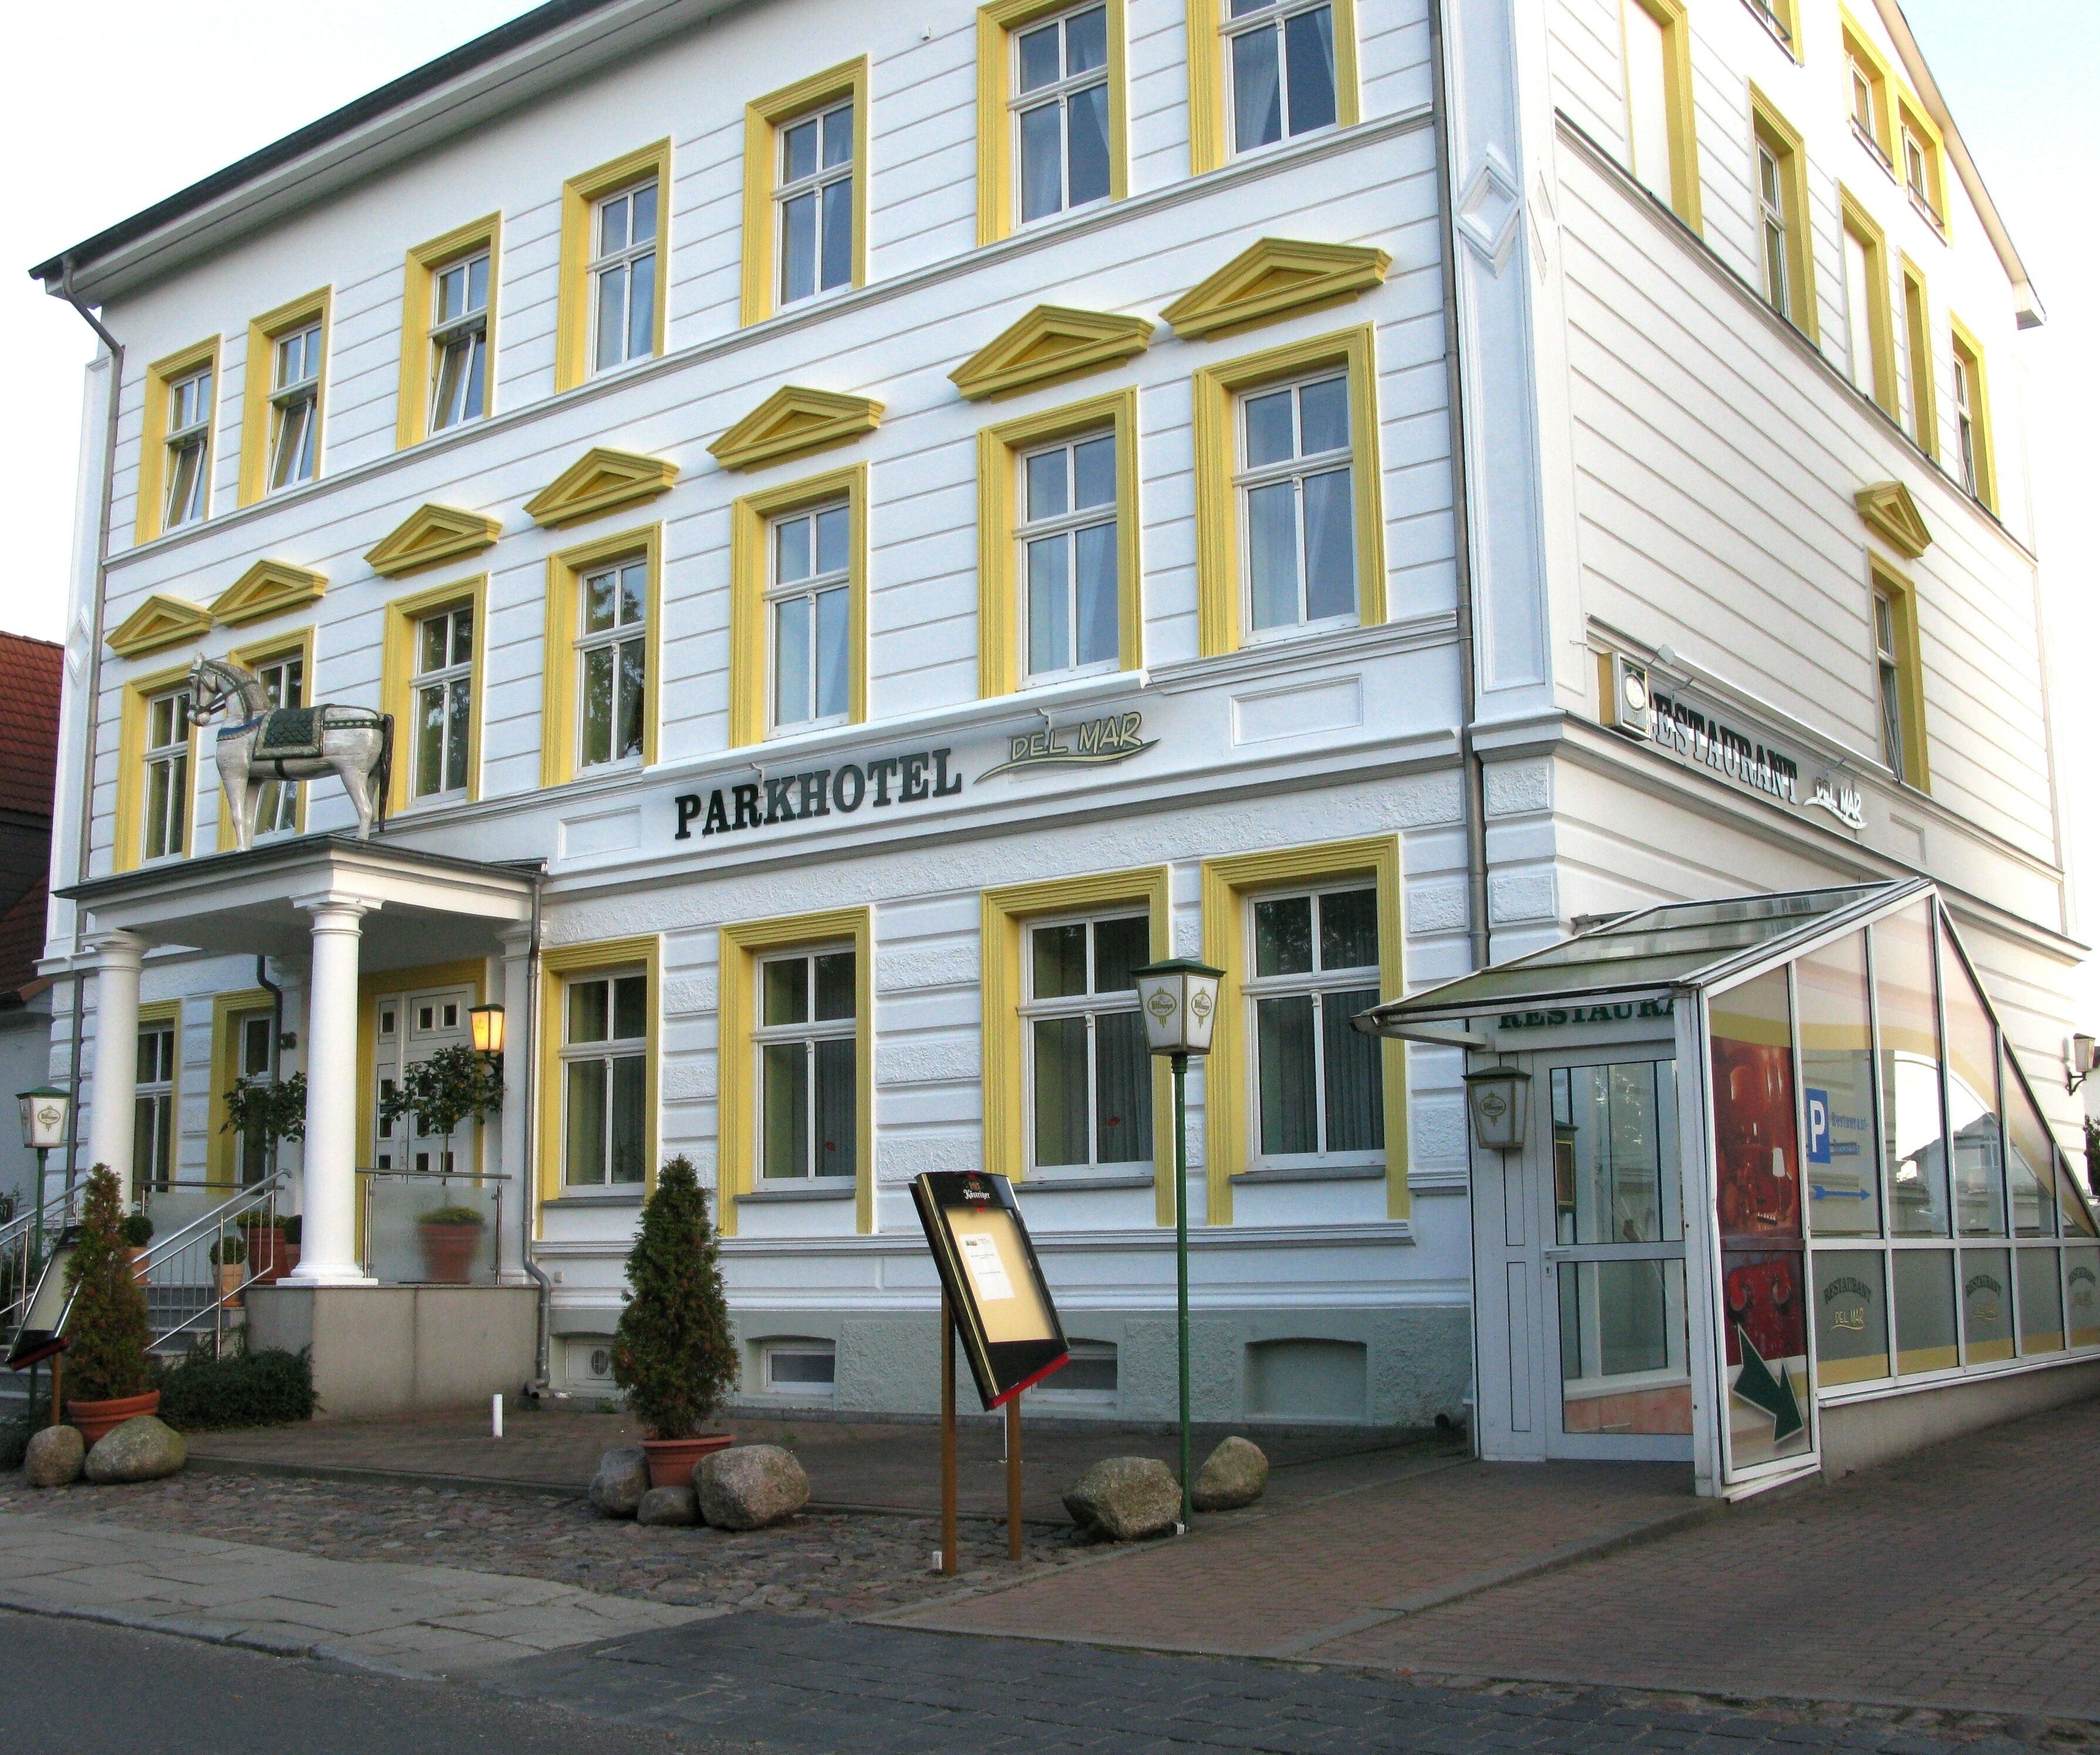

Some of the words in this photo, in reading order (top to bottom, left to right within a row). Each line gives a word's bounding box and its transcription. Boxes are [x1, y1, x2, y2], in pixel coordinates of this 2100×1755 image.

[674, 748, 962, 840] PARKHOTEL
[1011, 728, 1069, 759] DEL
[1077, 710, 1145, 755] MAR
[1649, 691, 1799, 805] ESTAURANT
[1815, 777, 1837, 806] DEL
[1841, 785, 1862, 823] MAR
[1809, 1099, 1825, 1153] P
[1824, 1277, 1872, 1304] RESTAURANT
[1965, 1274, 2001, 1297] RESTAURANT
[1835, 1311, 1849, 1324] DEL
[1850, 1307, 1865, 1325] MAR
